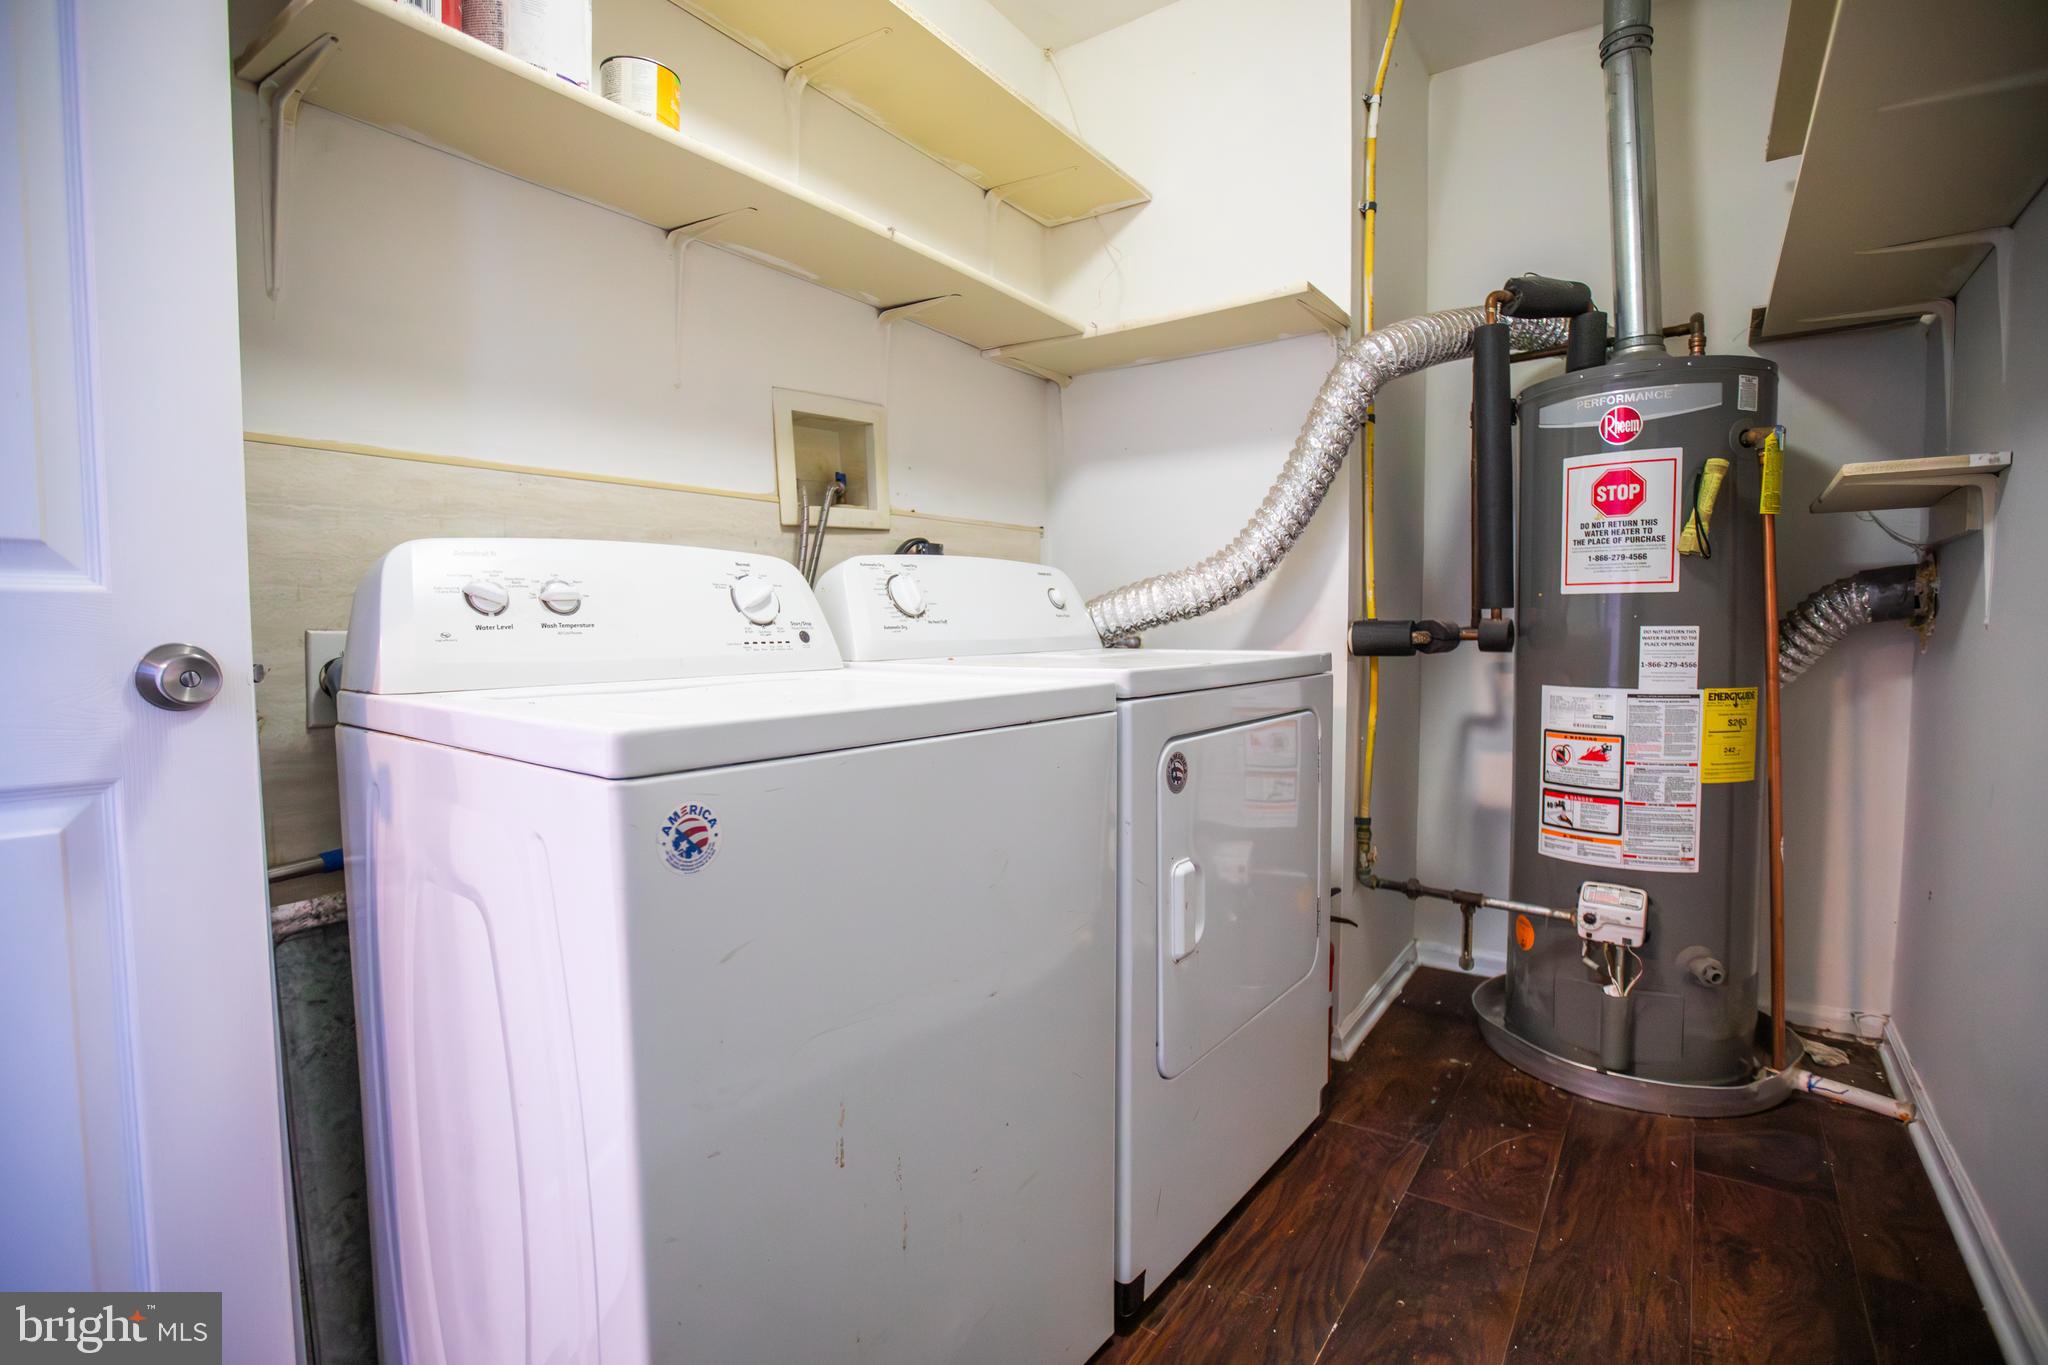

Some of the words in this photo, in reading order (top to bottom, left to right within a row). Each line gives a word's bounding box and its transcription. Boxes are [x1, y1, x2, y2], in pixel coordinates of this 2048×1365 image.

[1576, 390, 1673, 410] PERFORMANCE
[1604, 407, 1640, 439] Rheem
[1596, 483, 1641, 503] STOP
[1591, 521, 1605, 530] NOT
[1607, 519, 1638, 528] RETURN
[1640, 518, 1658, 526] THIS
[1584, 529, 1609, 538] WATER
[1611, 528, 1640, 536] HEATER
[1587, 537, 1610, 546] PLACE
[1624, 534, 1666, 543] PURCHASE
[1588, 552, 1648, 562] 1-866-279-4566
[661, 804, 718, 837] AMERICA
